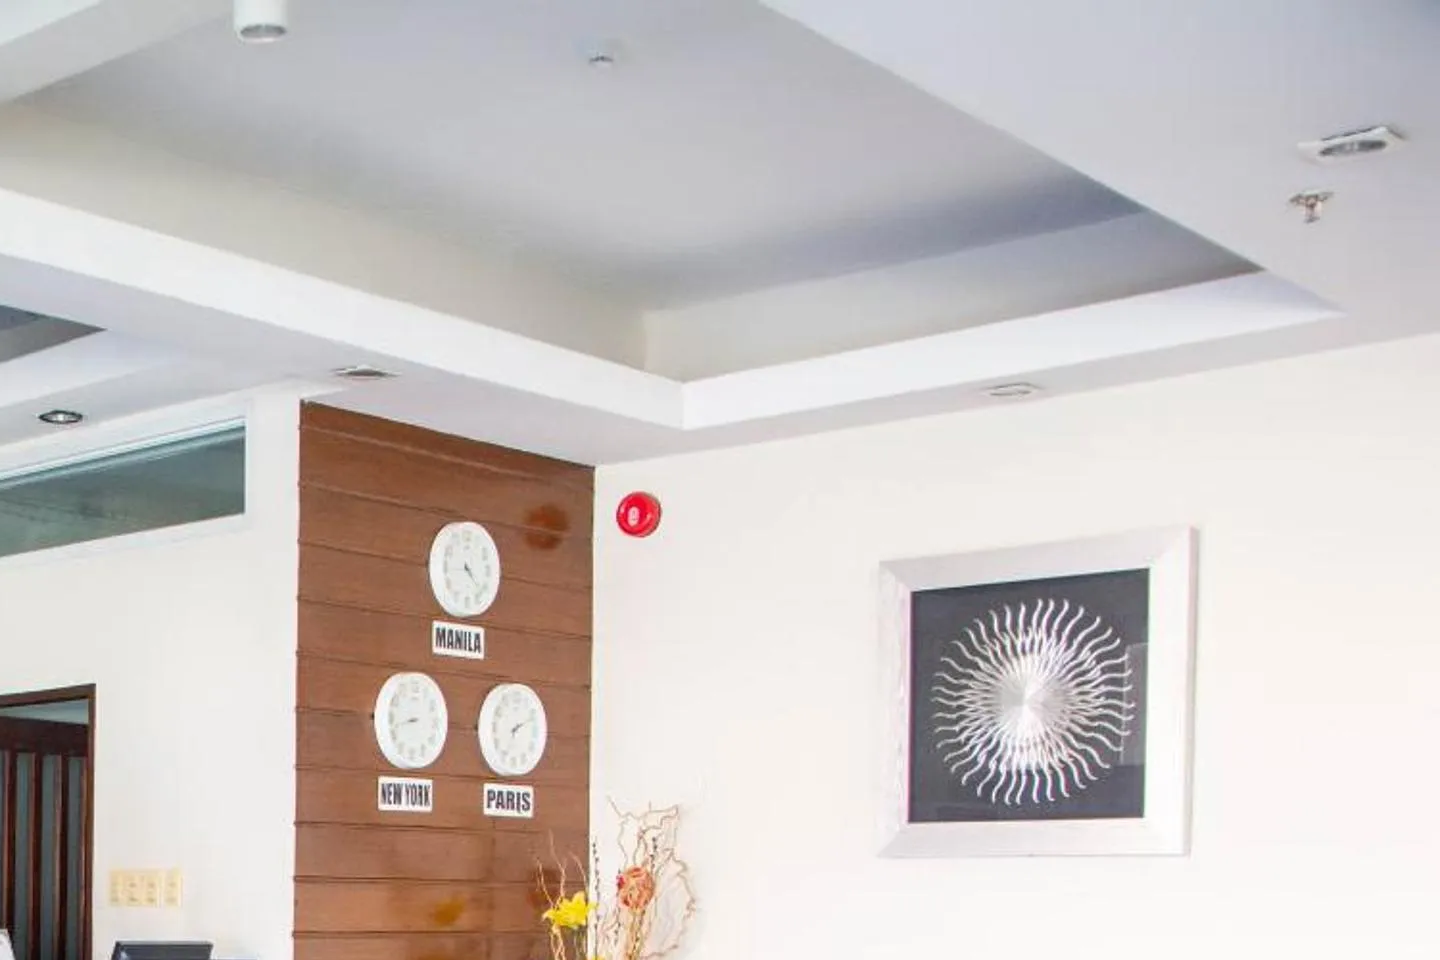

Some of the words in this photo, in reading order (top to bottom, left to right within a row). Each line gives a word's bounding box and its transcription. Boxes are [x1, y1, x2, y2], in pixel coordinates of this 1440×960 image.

[435, 627, 482, 653] MANILA
[381, 783, 402, 805] NEW
[404, 784, 430, 807] YORK
[486, 789, 531, 814] PARIS
